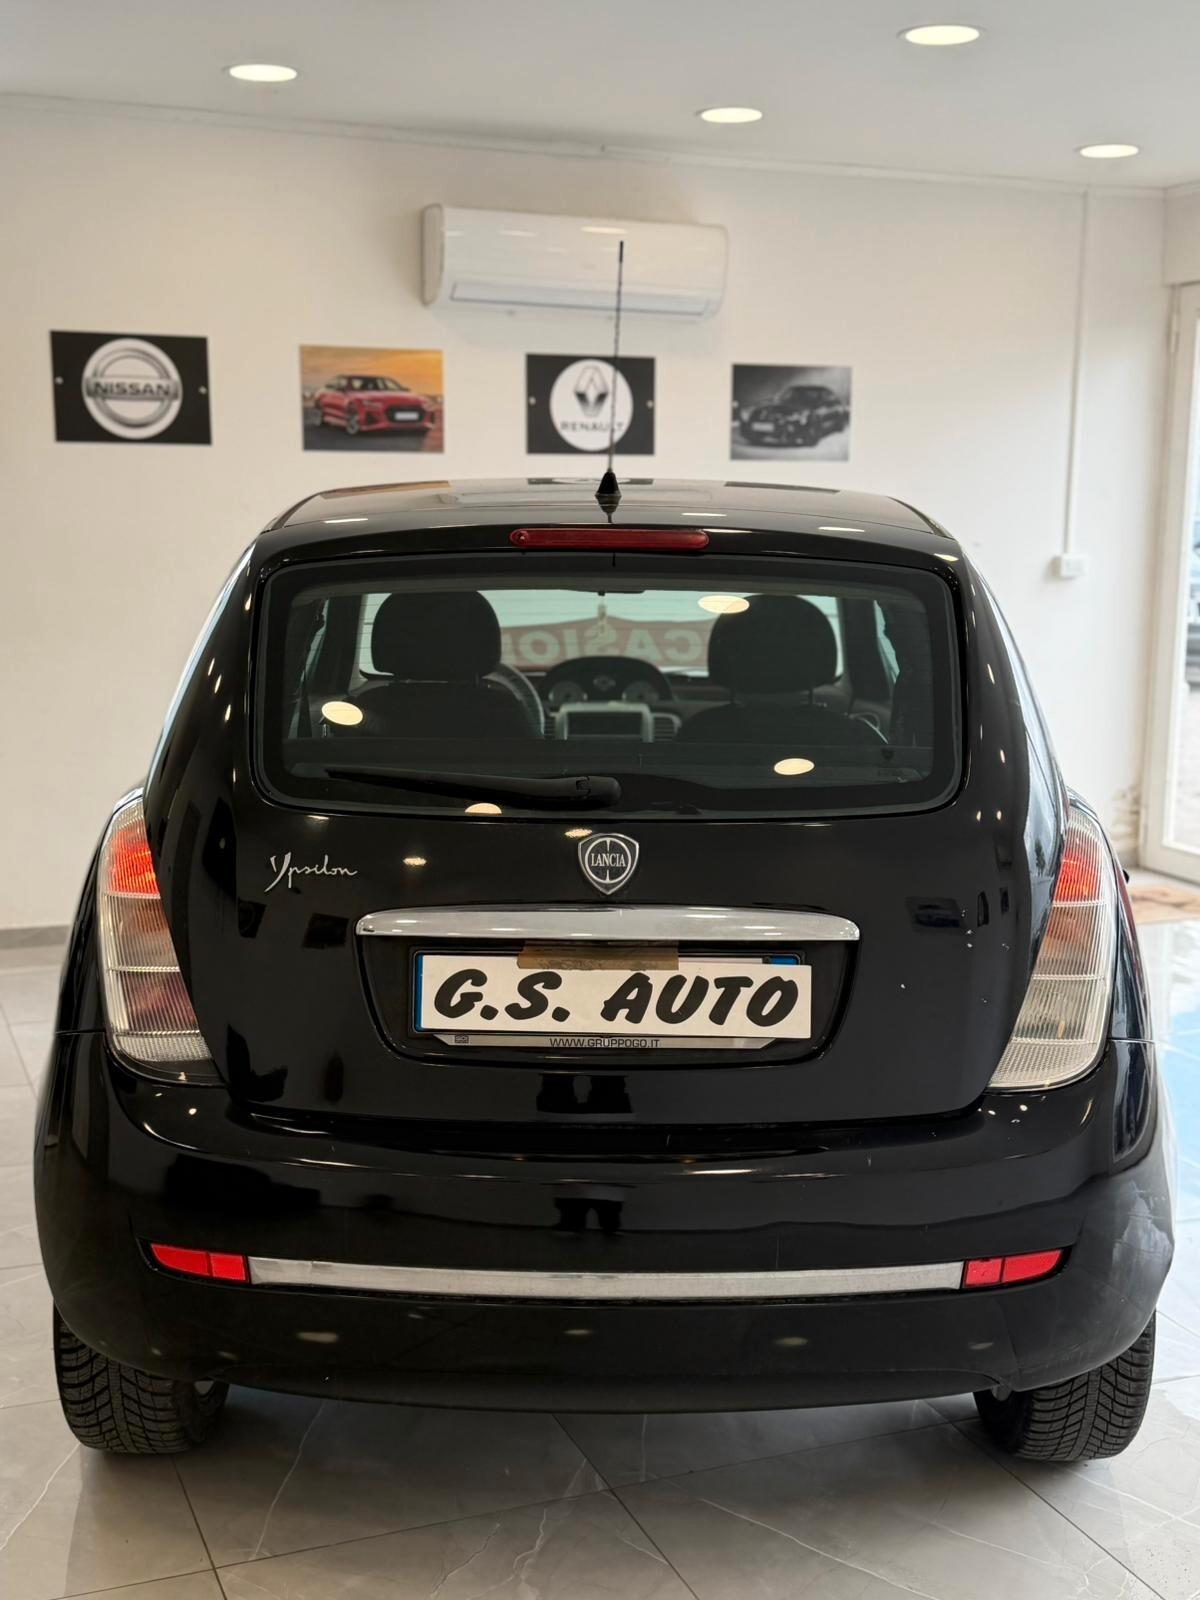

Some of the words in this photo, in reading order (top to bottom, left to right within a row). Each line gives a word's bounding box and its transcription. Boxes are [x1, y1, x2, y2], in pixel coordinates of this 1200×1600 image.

[94, 382, 170, 397] NISSAN
[591, 853, 626, 867] LANCIA
[264, 851, 358, 892] Ypsilon
[434, 968, 570, 1022] G.S.
[600, 972, 799, 1027] AUTO
[549, 1037, 660, 1047] WWW.GRUPPOGO.IT
